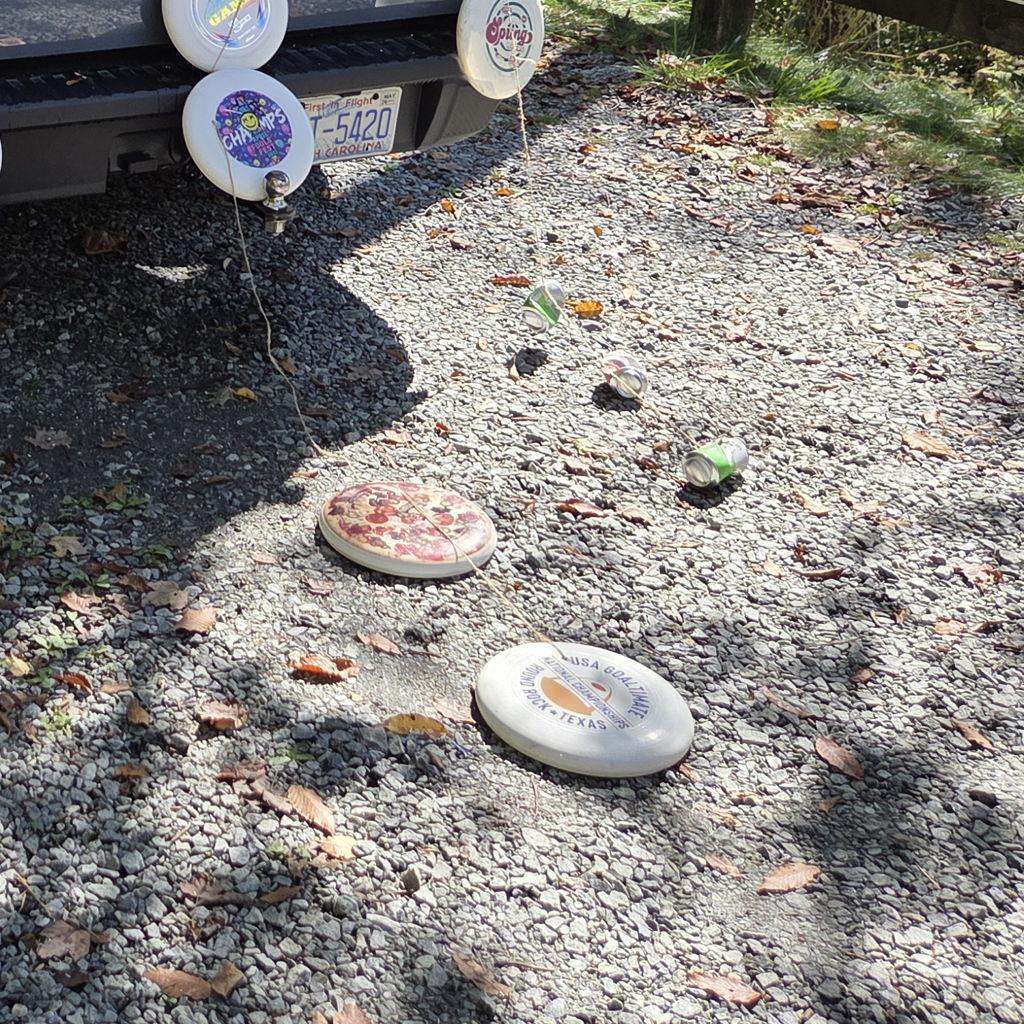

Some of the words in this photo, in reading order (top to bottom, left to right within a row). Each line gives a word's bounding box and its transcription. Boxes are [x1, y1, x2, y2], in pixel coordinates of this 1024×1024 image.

[304, 101, 325, 113] First
[345, 96, 374, 108] Flight
[310, 107, 392, 145] T-5420
[222, 108, 286, 151] CHAMPS
[325, 141, 383, 157] CAROLINA
[523, 688, 552, 712] ROCK
[560, 710, 607, 731] TEXAS
[571, 656, 600, 671] USA
[603, 665, 650, 720] GOALTIMATE
[571, 679, 628, 730] CHAMPIONSHIPS
